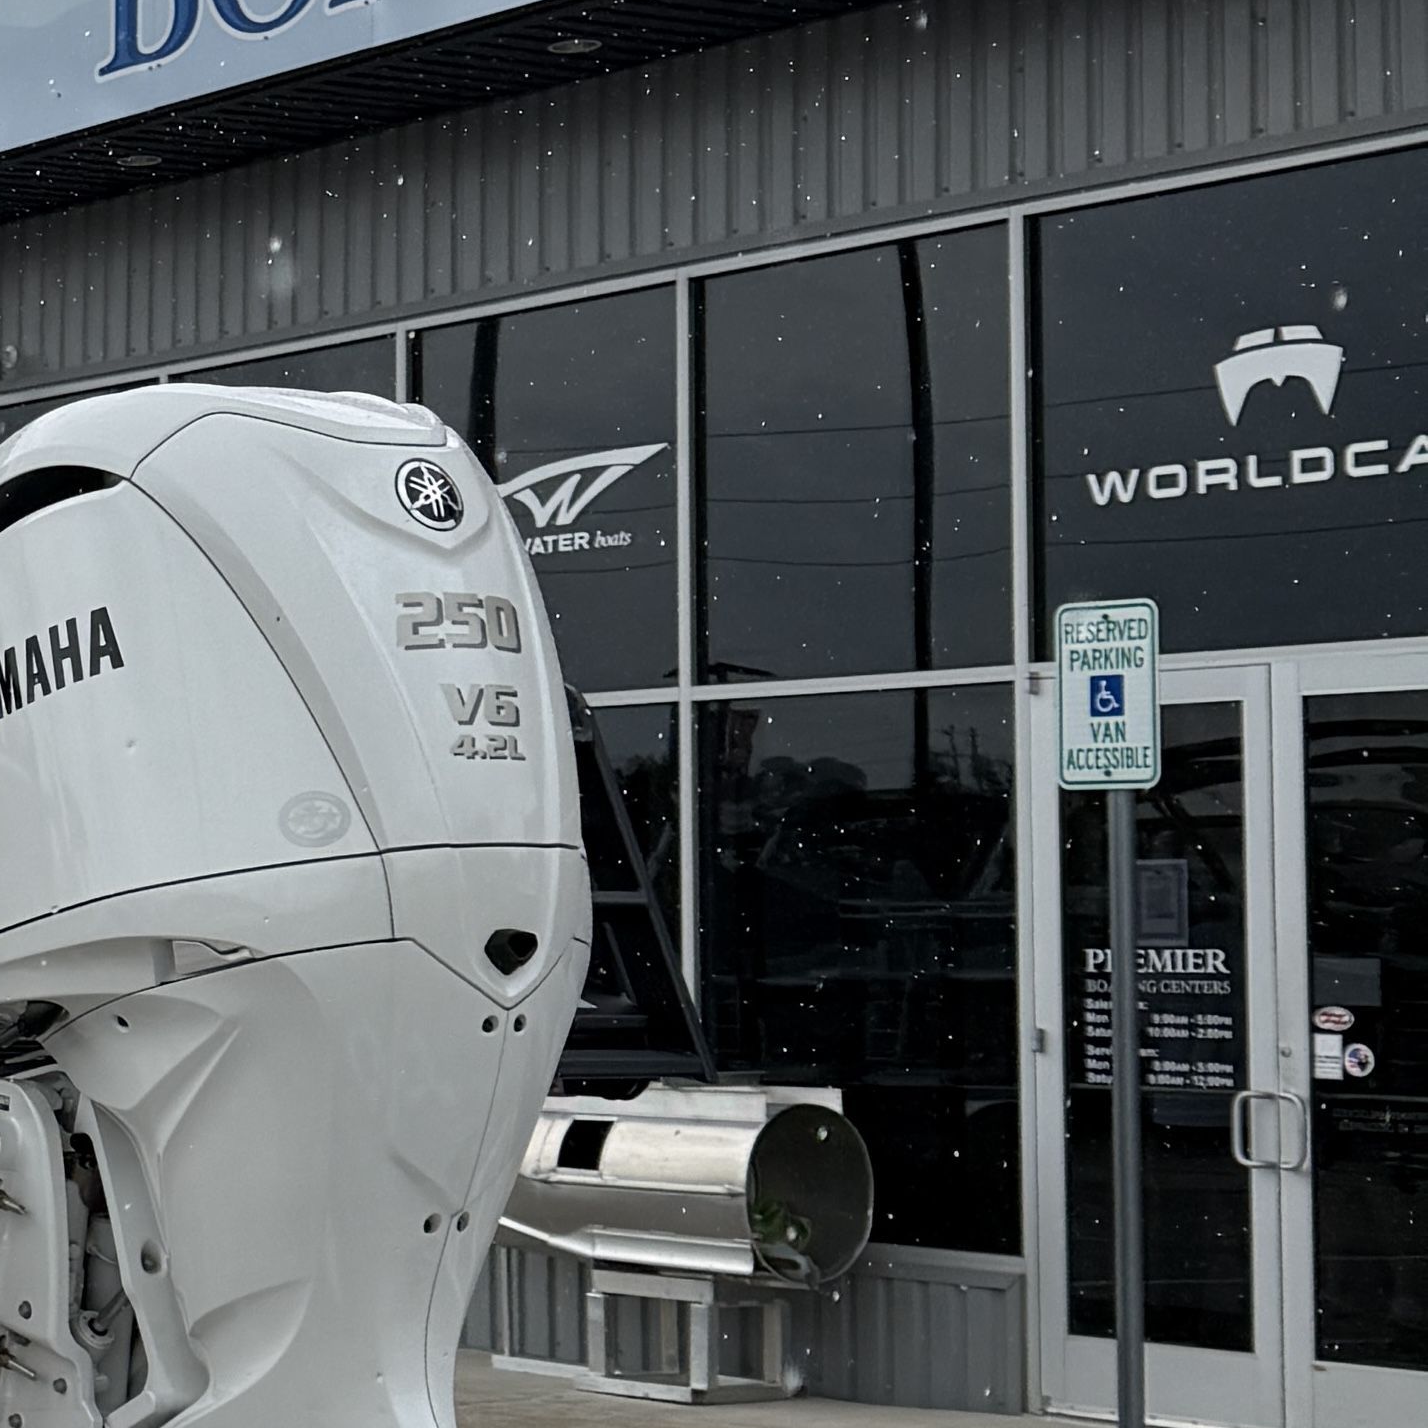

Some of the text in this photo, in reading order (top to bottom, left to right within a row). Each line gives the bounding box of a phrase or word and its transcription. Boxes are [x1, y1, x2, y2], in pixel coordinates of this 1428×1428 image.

[394, 591, 522, 654] 250
[1063, 618, 1149, 645] RESERVED
[1069, 647, 1145, 672] PARKING
[438, 683, 521, 728] V6
[1090, 721, 1127, 744] VAN
[449, 734, 526, 761] 4.2L
[1066, 746, 1152, 771] ACCESSIBLE
[1160, 980, 1232, 995] CENTERS
